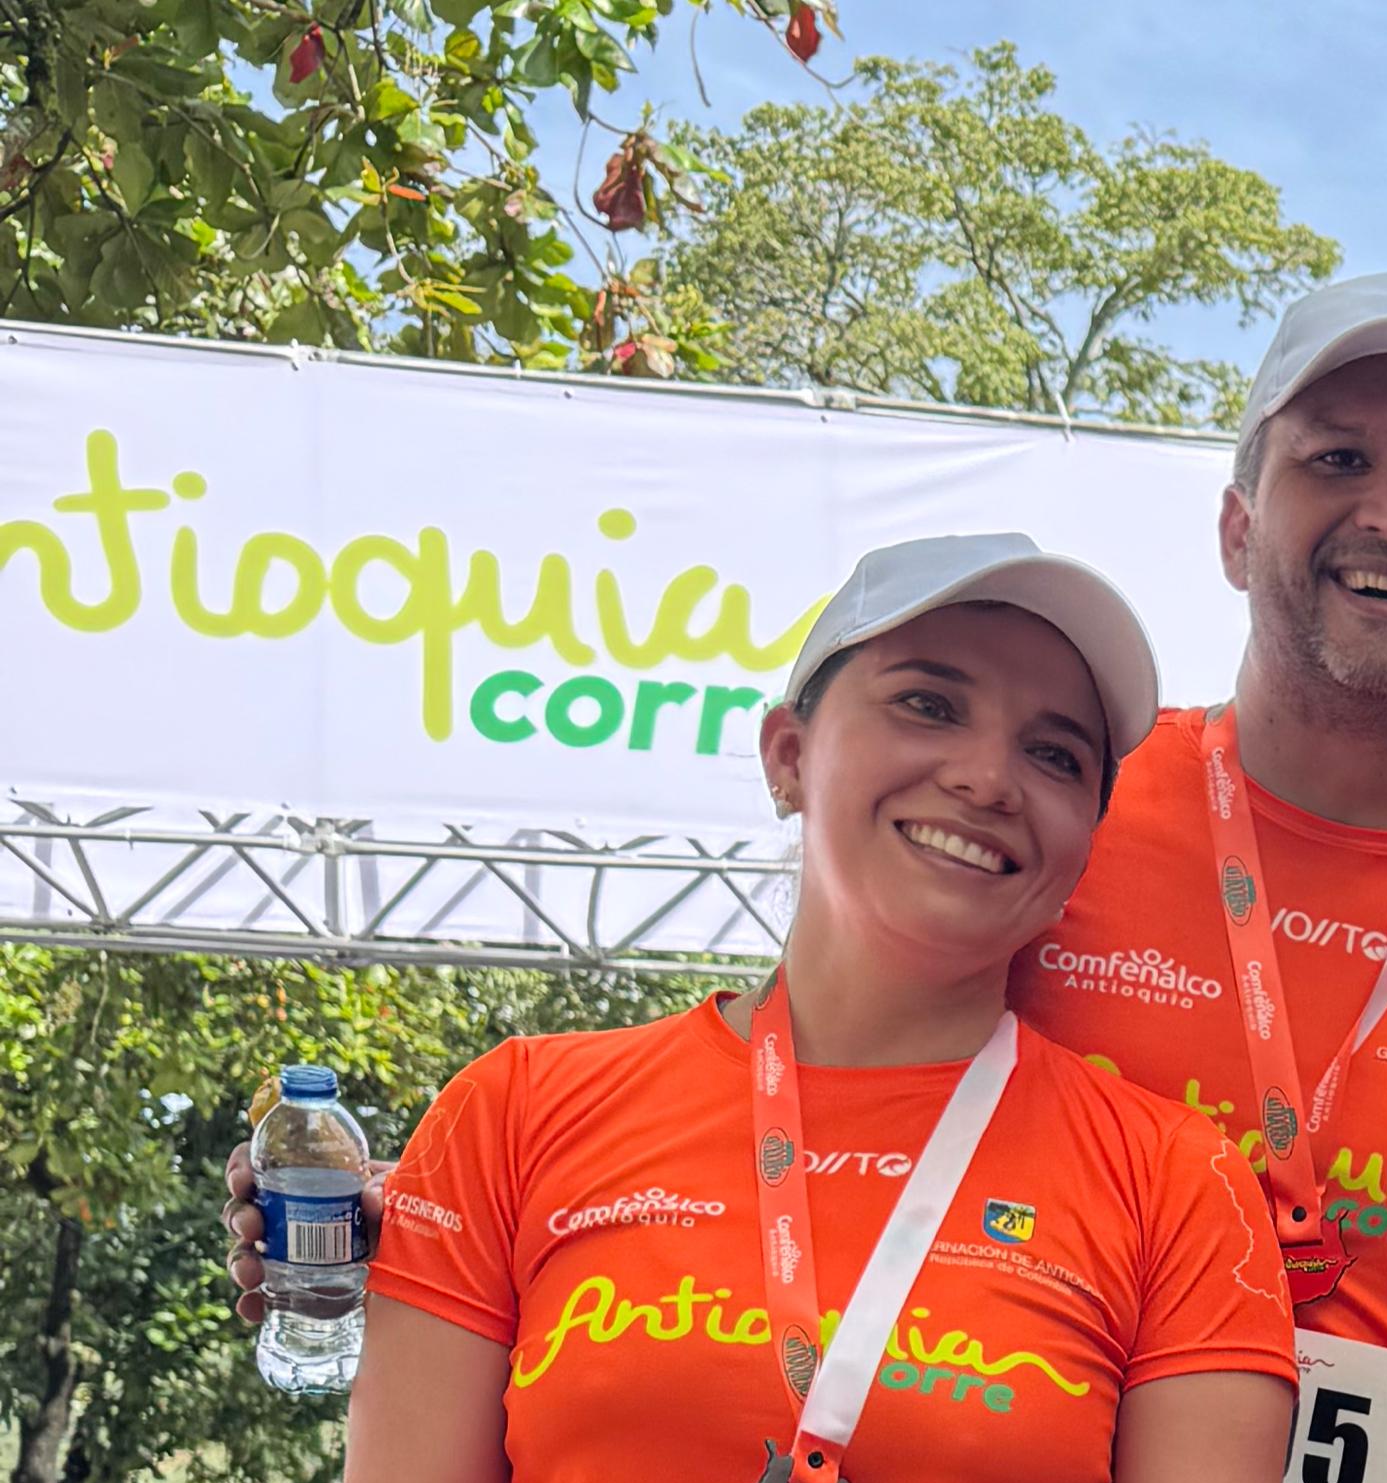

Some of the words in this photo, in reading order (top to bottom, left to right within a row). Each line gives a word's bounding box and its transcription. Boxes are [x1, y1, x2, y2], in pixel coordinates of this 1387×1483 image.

[0, 428, 832, 742] ntioquia
[469, 668, 782, 756] corr
[1039, 943, 1222, 999] Comfenalco
[1065, 974, 1194, 1009] Antioquia
[878, 1361, 1015, 1413] orre
